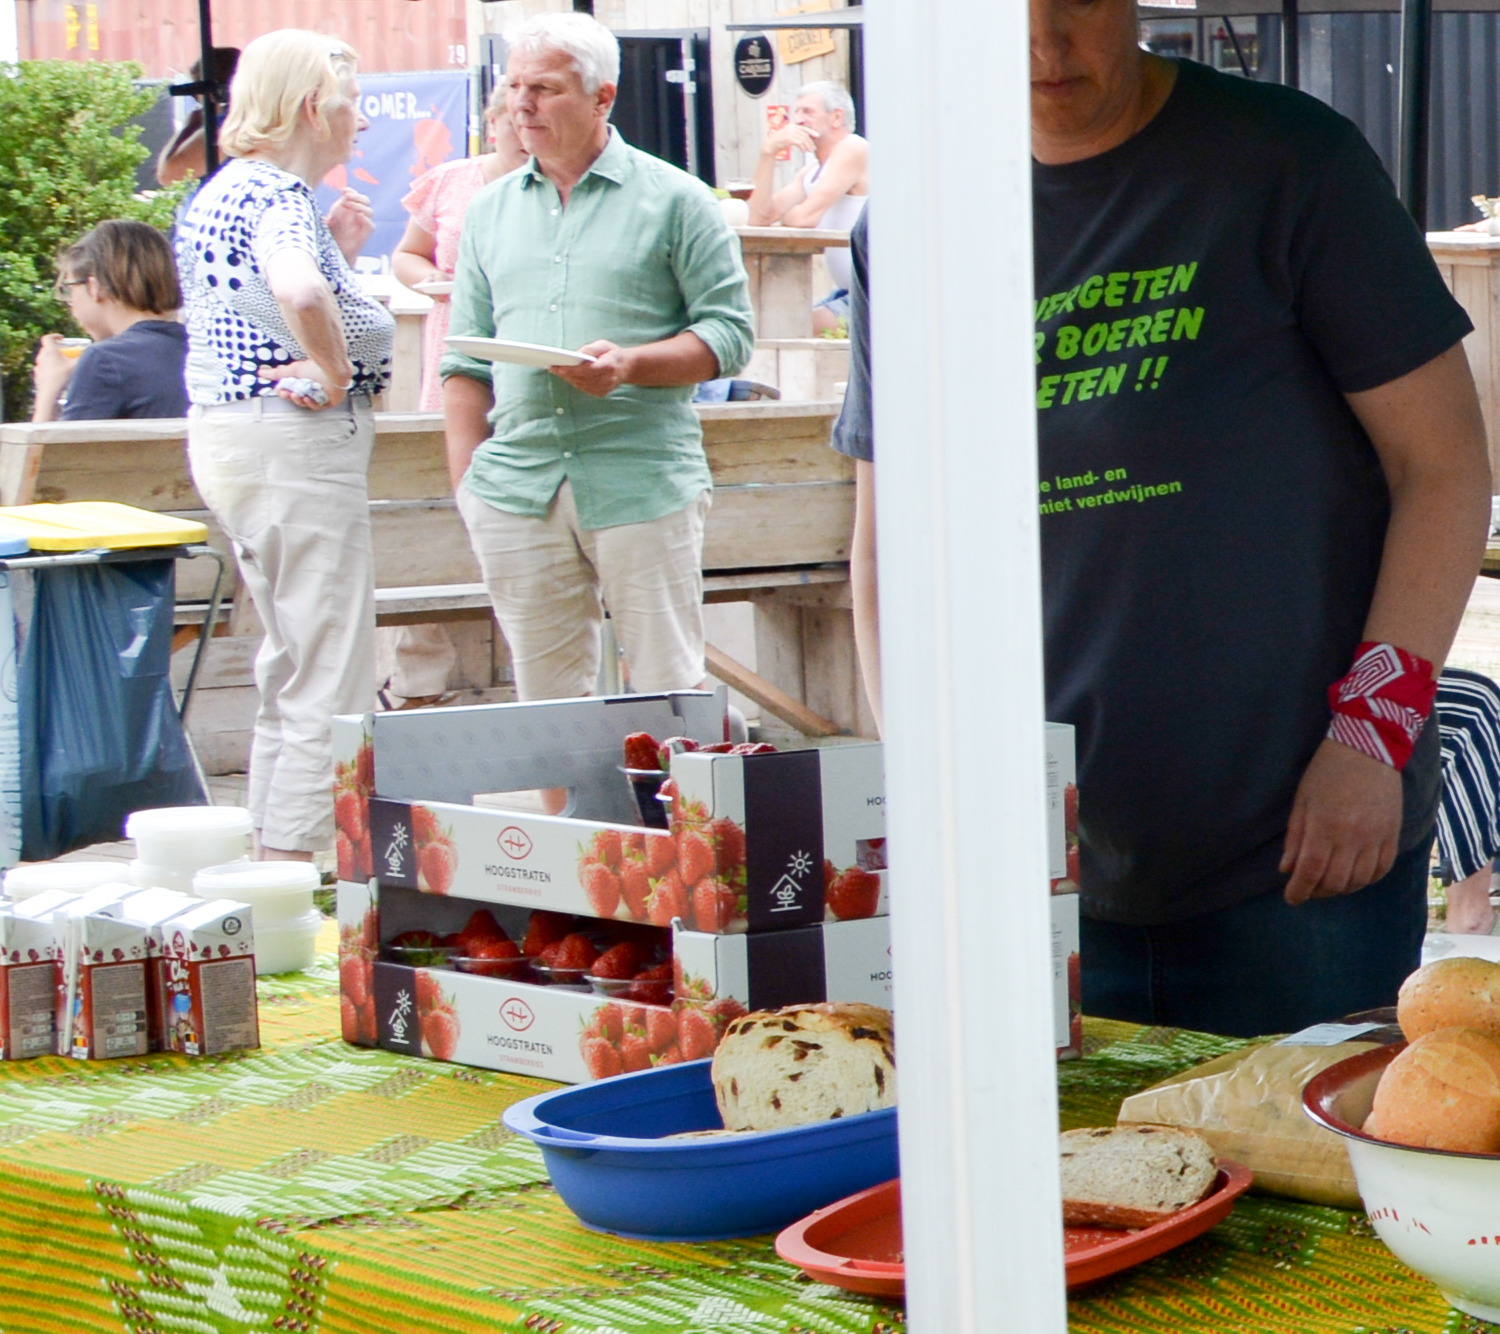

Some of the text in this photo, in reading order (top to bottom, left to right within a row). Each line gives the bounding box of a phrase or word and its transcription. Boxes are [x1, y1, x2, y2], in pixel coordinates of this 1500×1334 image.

[1055, 306, 1205, 361] BOEREN
[1036, 355, 1169, 409] ETEN !!
[1055, 470, 1100, 492] land-
[1105, 466, 1128, 483] en
[1039, 478, 1183, 516] niet verdwijnen
[484, 864, 552, 883] HOOGSTRATEN
[486, 1034, 554, 1056] HOOGSTRATEN
